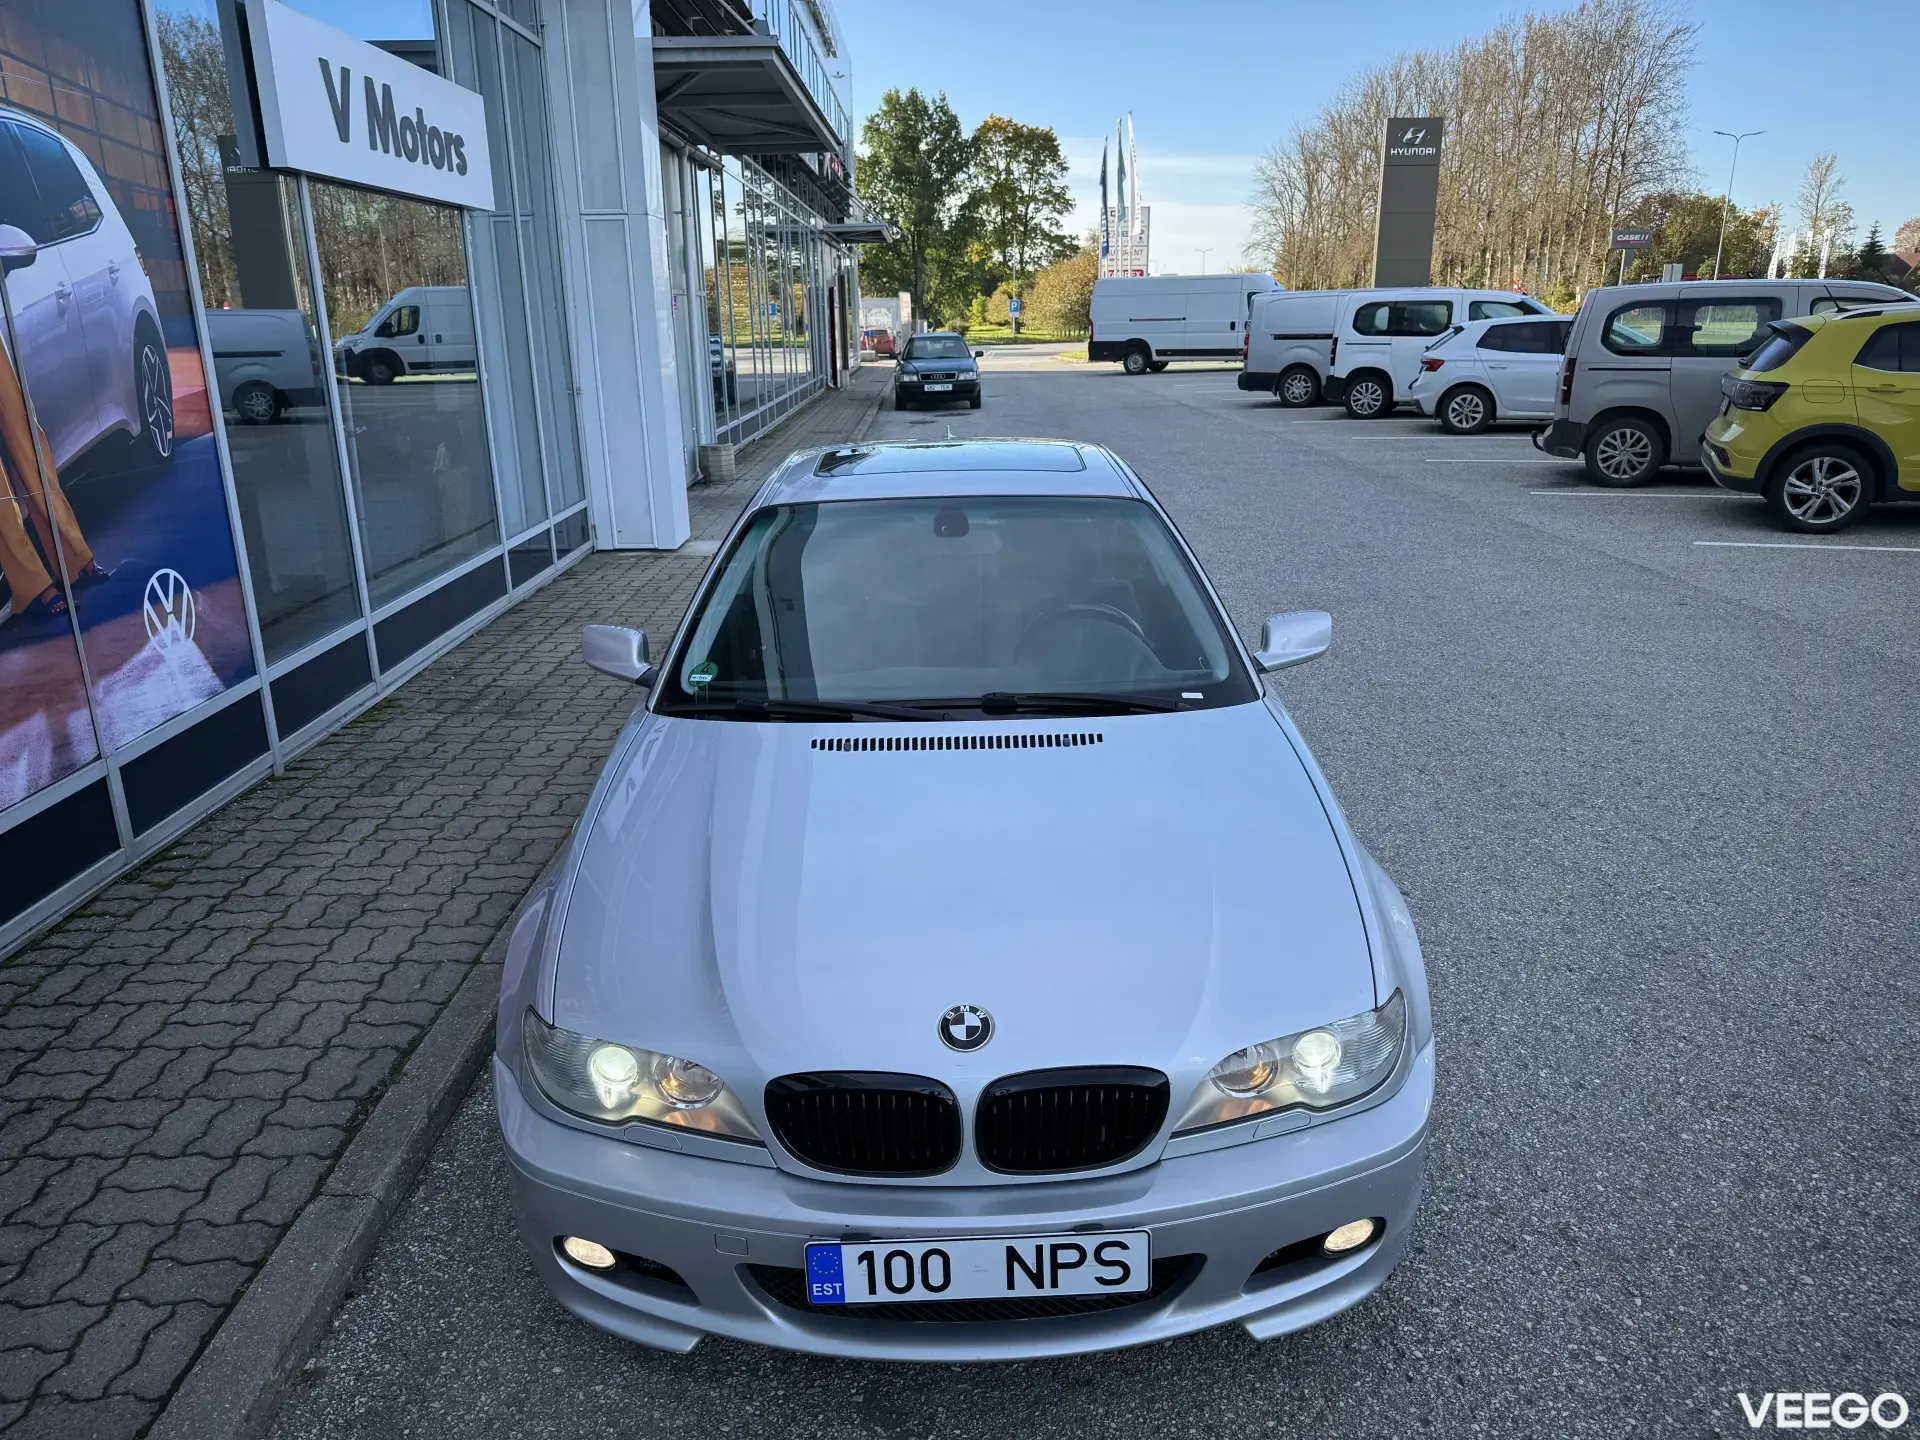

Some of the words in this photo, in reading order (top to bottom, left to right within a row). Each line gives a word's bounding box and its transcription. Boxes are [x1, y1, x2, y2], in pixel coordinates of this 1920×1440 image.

[318, 57, 351, 143] V
[364, 75, 468, 176] Motors
[1390, 147, 1436, 156] HYUNDAI
[1011, 301, 1017, 311] P
[945, 1005, 986, 1020] BMW
[857, 1248, 952, 1296] 100
[1005, 1240, 1132, 1291] NPS
[812, 1283, 843, 1296] EST
